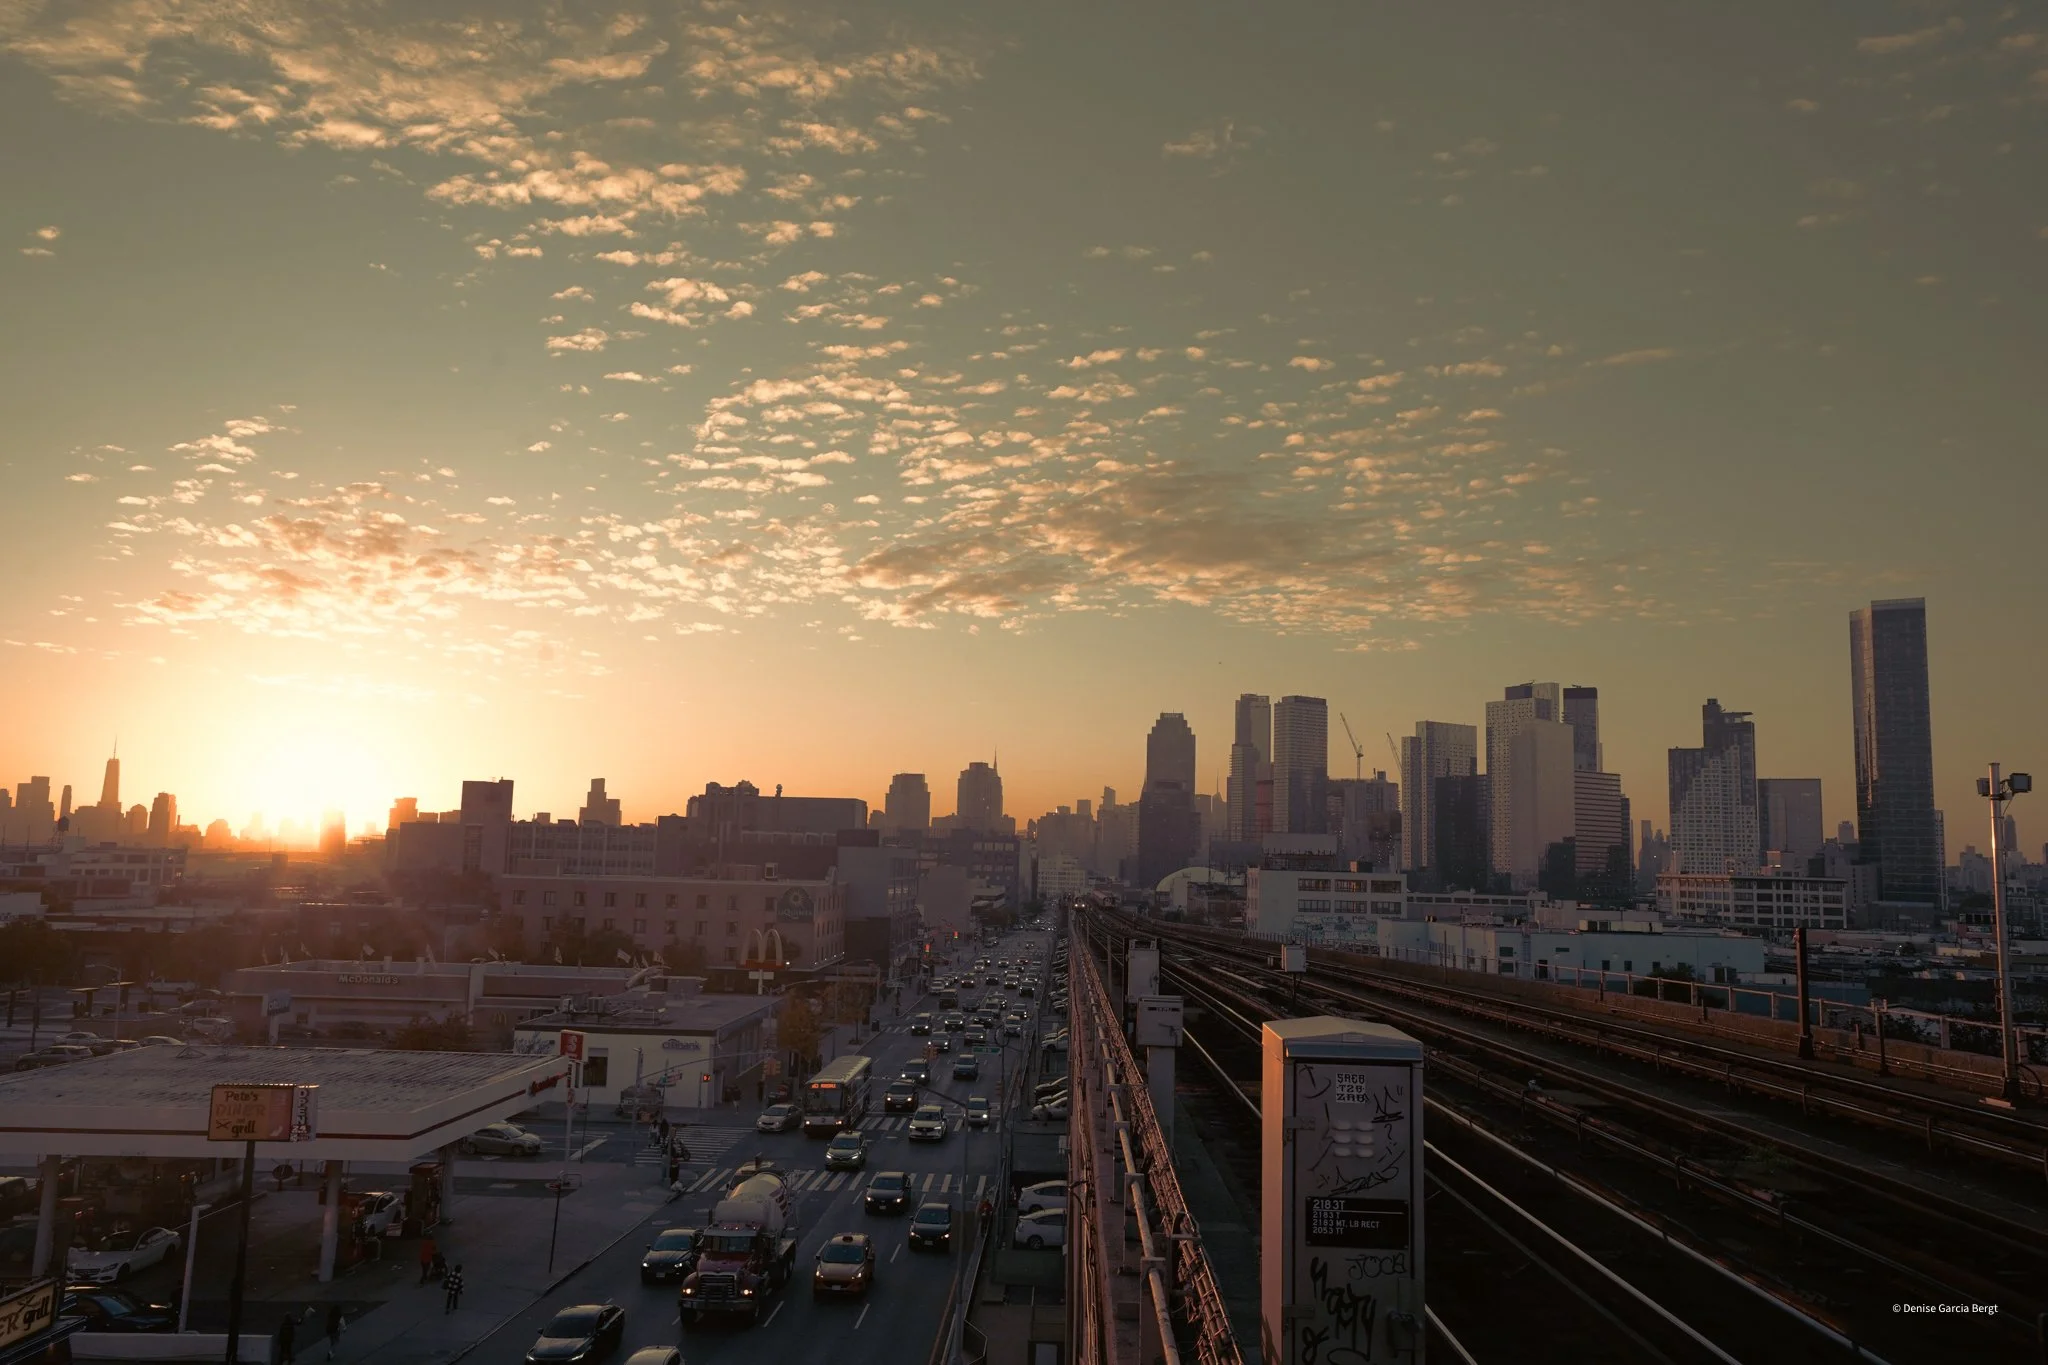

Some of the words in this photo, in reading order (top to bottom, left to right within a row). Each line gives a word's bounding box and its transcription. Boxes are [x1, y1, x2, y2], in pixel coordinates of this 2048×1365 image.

[338, 975, 399, 985] McDonald's
[224, 1091, 259, 1102] Pete's
[215, 1103, 266, 1116] DINER
[231, 1120, 255, 1138] grill
[1361, 1220, 1380, 1229] RECT
